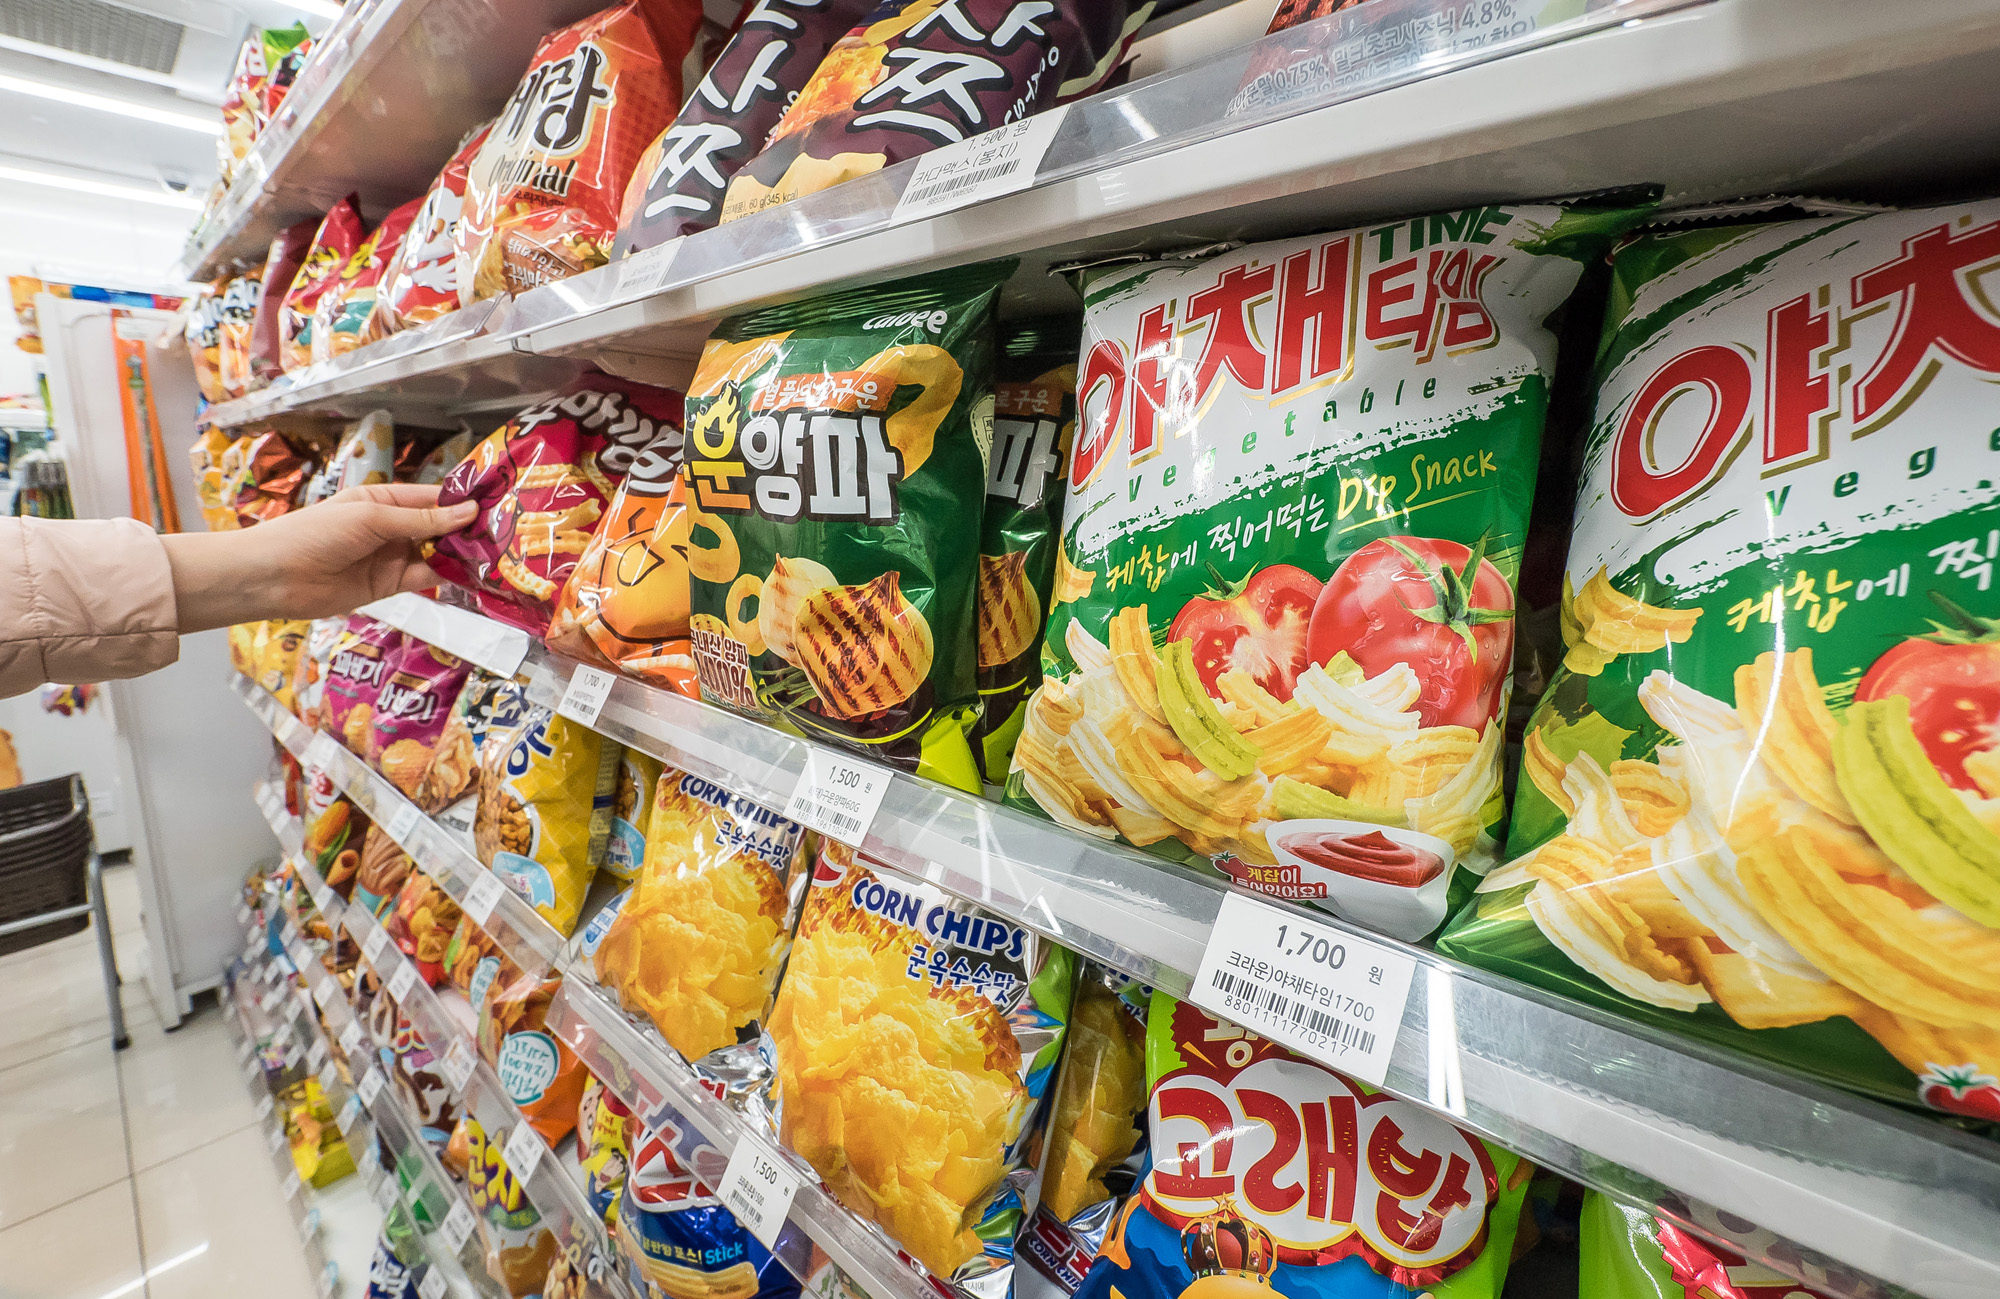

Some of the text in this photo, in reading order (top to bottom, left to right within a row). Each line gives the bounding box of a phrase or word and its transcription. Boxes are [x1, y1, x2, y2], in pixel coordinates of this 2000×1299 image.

[968, 119, 1032, 153] 1,500 원
[1368, 203, 1516, 264] TIME
[1404, 445, 1499, 506] Snack
[680, 773, 733, 809] CORN
[829, 765, 873, 794] 1,500 원
[1247, 866, 1298, 885] 케찹이
[852, 878, 1028, 963] CORN CHIPS
[906, 943, 1016, 1009] 군옥수수맛
[1275, 923, 1385, 987] 1,700 원
[1225, 950, 1376, 1023] 크라운)야채타임1700
[1223, 993, 1350, 1058] 8801111770217
[752, 1155, 778, 1185] 1,500
[1150, 1086, 1472, 1253] 고래밥
[704, 1241, 744, 1265] Stick
